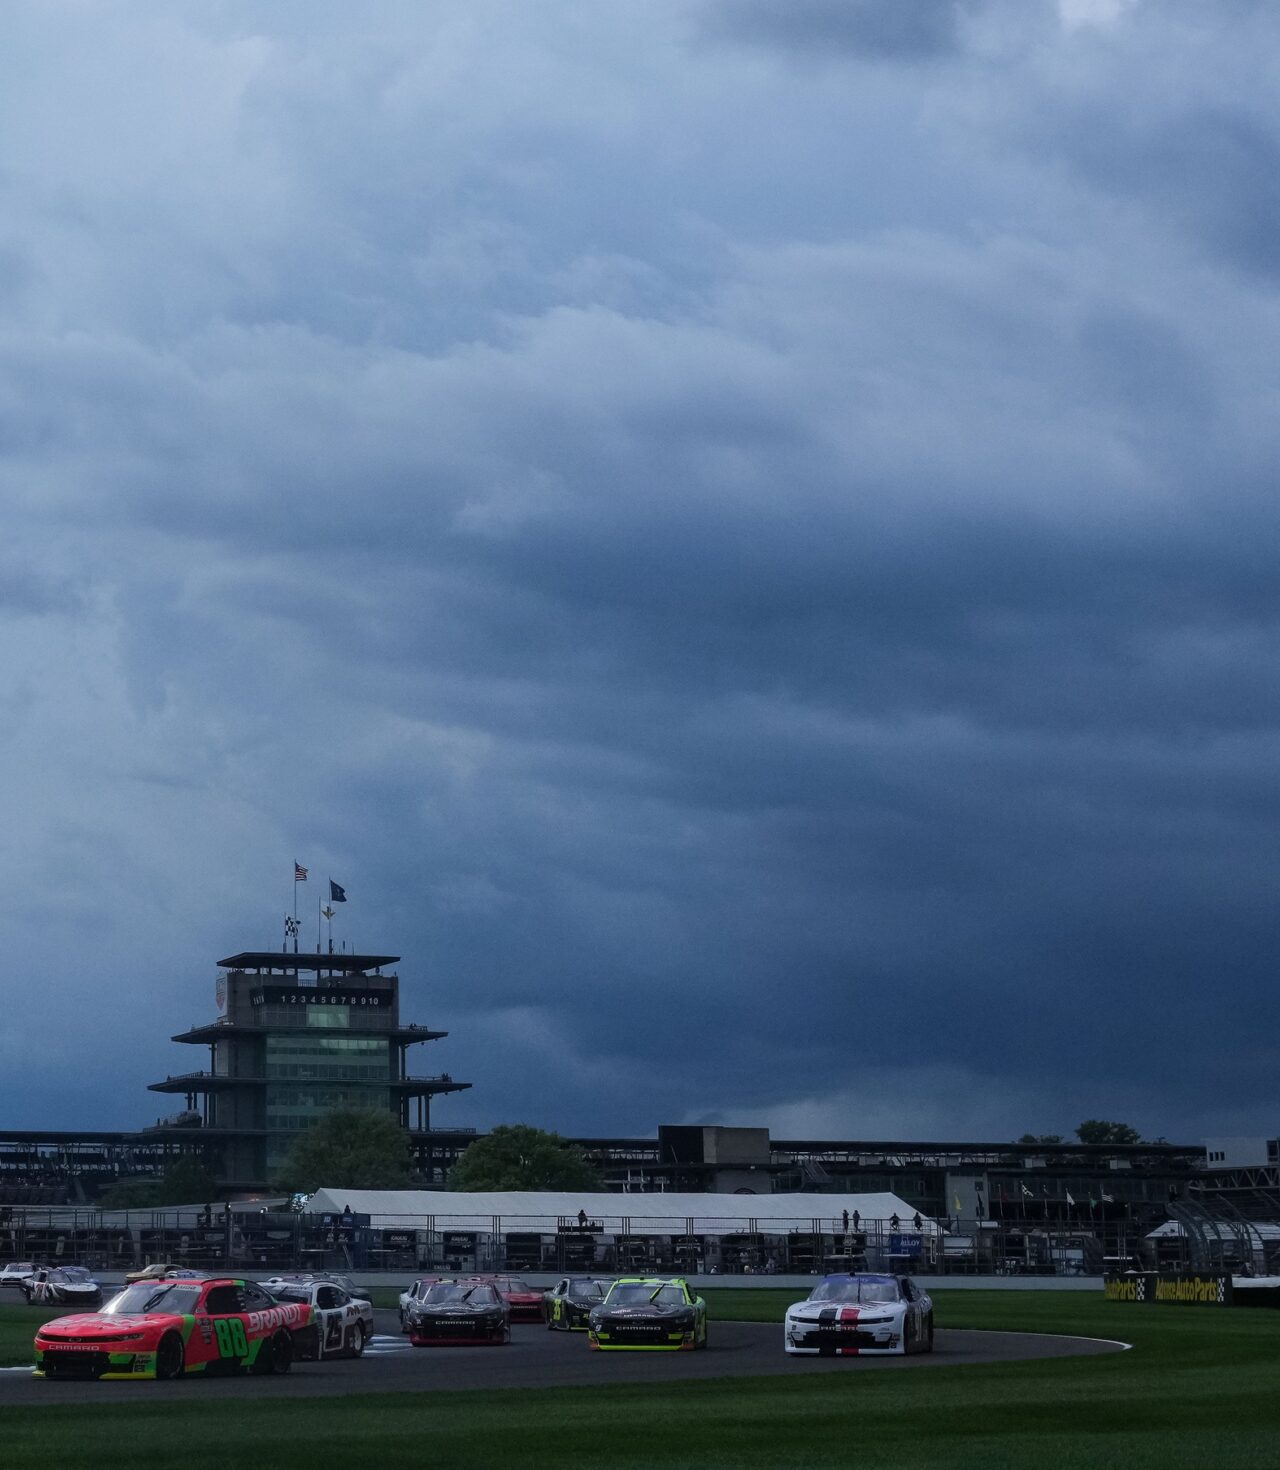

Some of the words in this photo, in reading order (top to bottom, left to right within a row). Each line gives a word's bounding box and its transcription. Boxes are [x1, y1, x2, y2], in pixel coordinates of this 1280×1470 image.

[281, 995, 286, 1003] 1
[291, 995, 296, 1003] 2
[301, 995, 306, 1003] 3
[310, 995, 316, 1003] 4
[321, 996, 326, 1004] 5
[331, 996, 336, 1004] 6
[340, 996, 346, 1004] 7
[351, 997, 356, 1005] 8
[361, 997, 366, 1005] 9
[368, 997, 378, 1005] 10
[247, 1303, 302, 1333] BRANDT
[214, 1318, 249, 1358] 88
